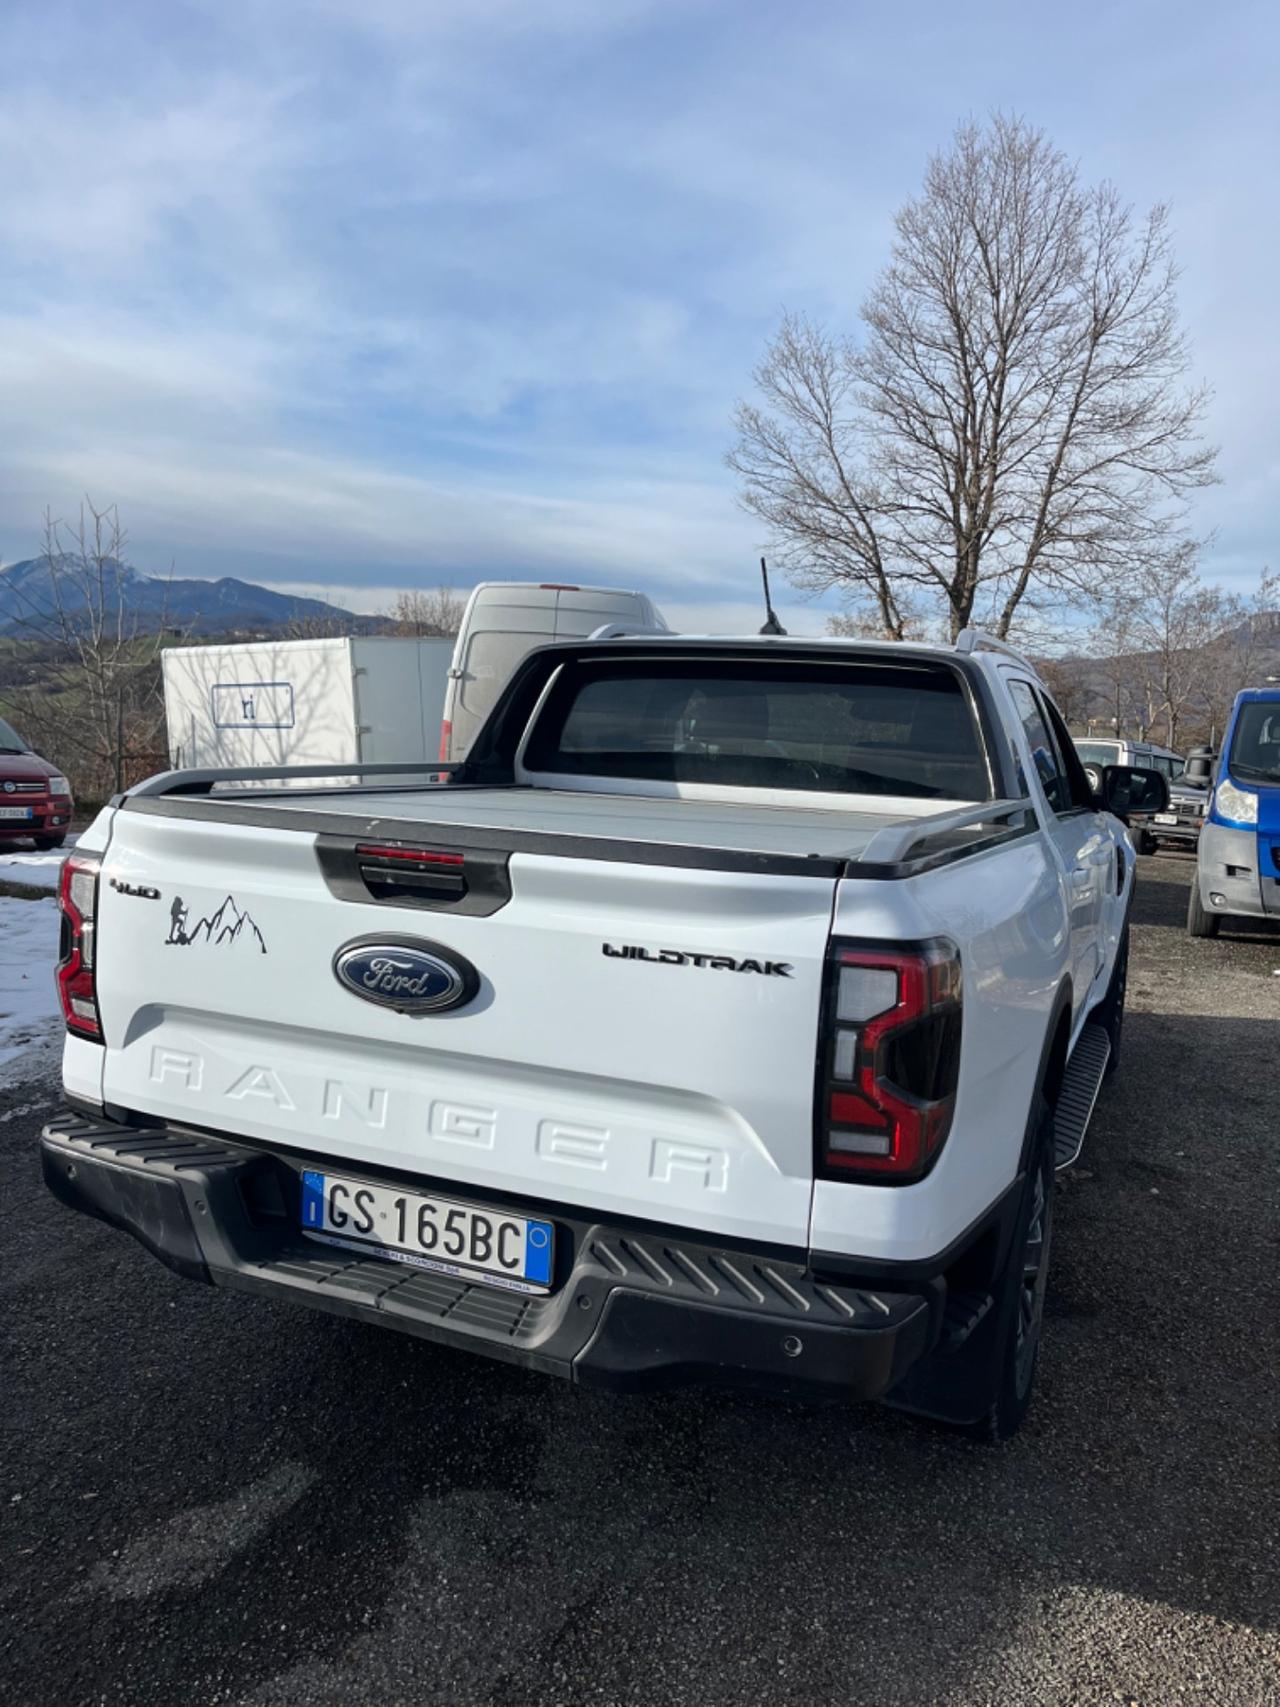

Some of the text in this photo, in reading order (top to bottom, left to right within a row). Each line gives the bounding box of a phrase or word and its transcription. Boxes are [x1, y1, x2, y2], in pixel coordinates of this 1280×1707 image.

[363, 957, 429, 994] Ford
[602, 942, 795, 979] WILDTRAK
[149, 1045, 731, 1194] RANGER
[328, 1183, 375, 1234] GS
[394, 1198, 521, 1269] 165BC
